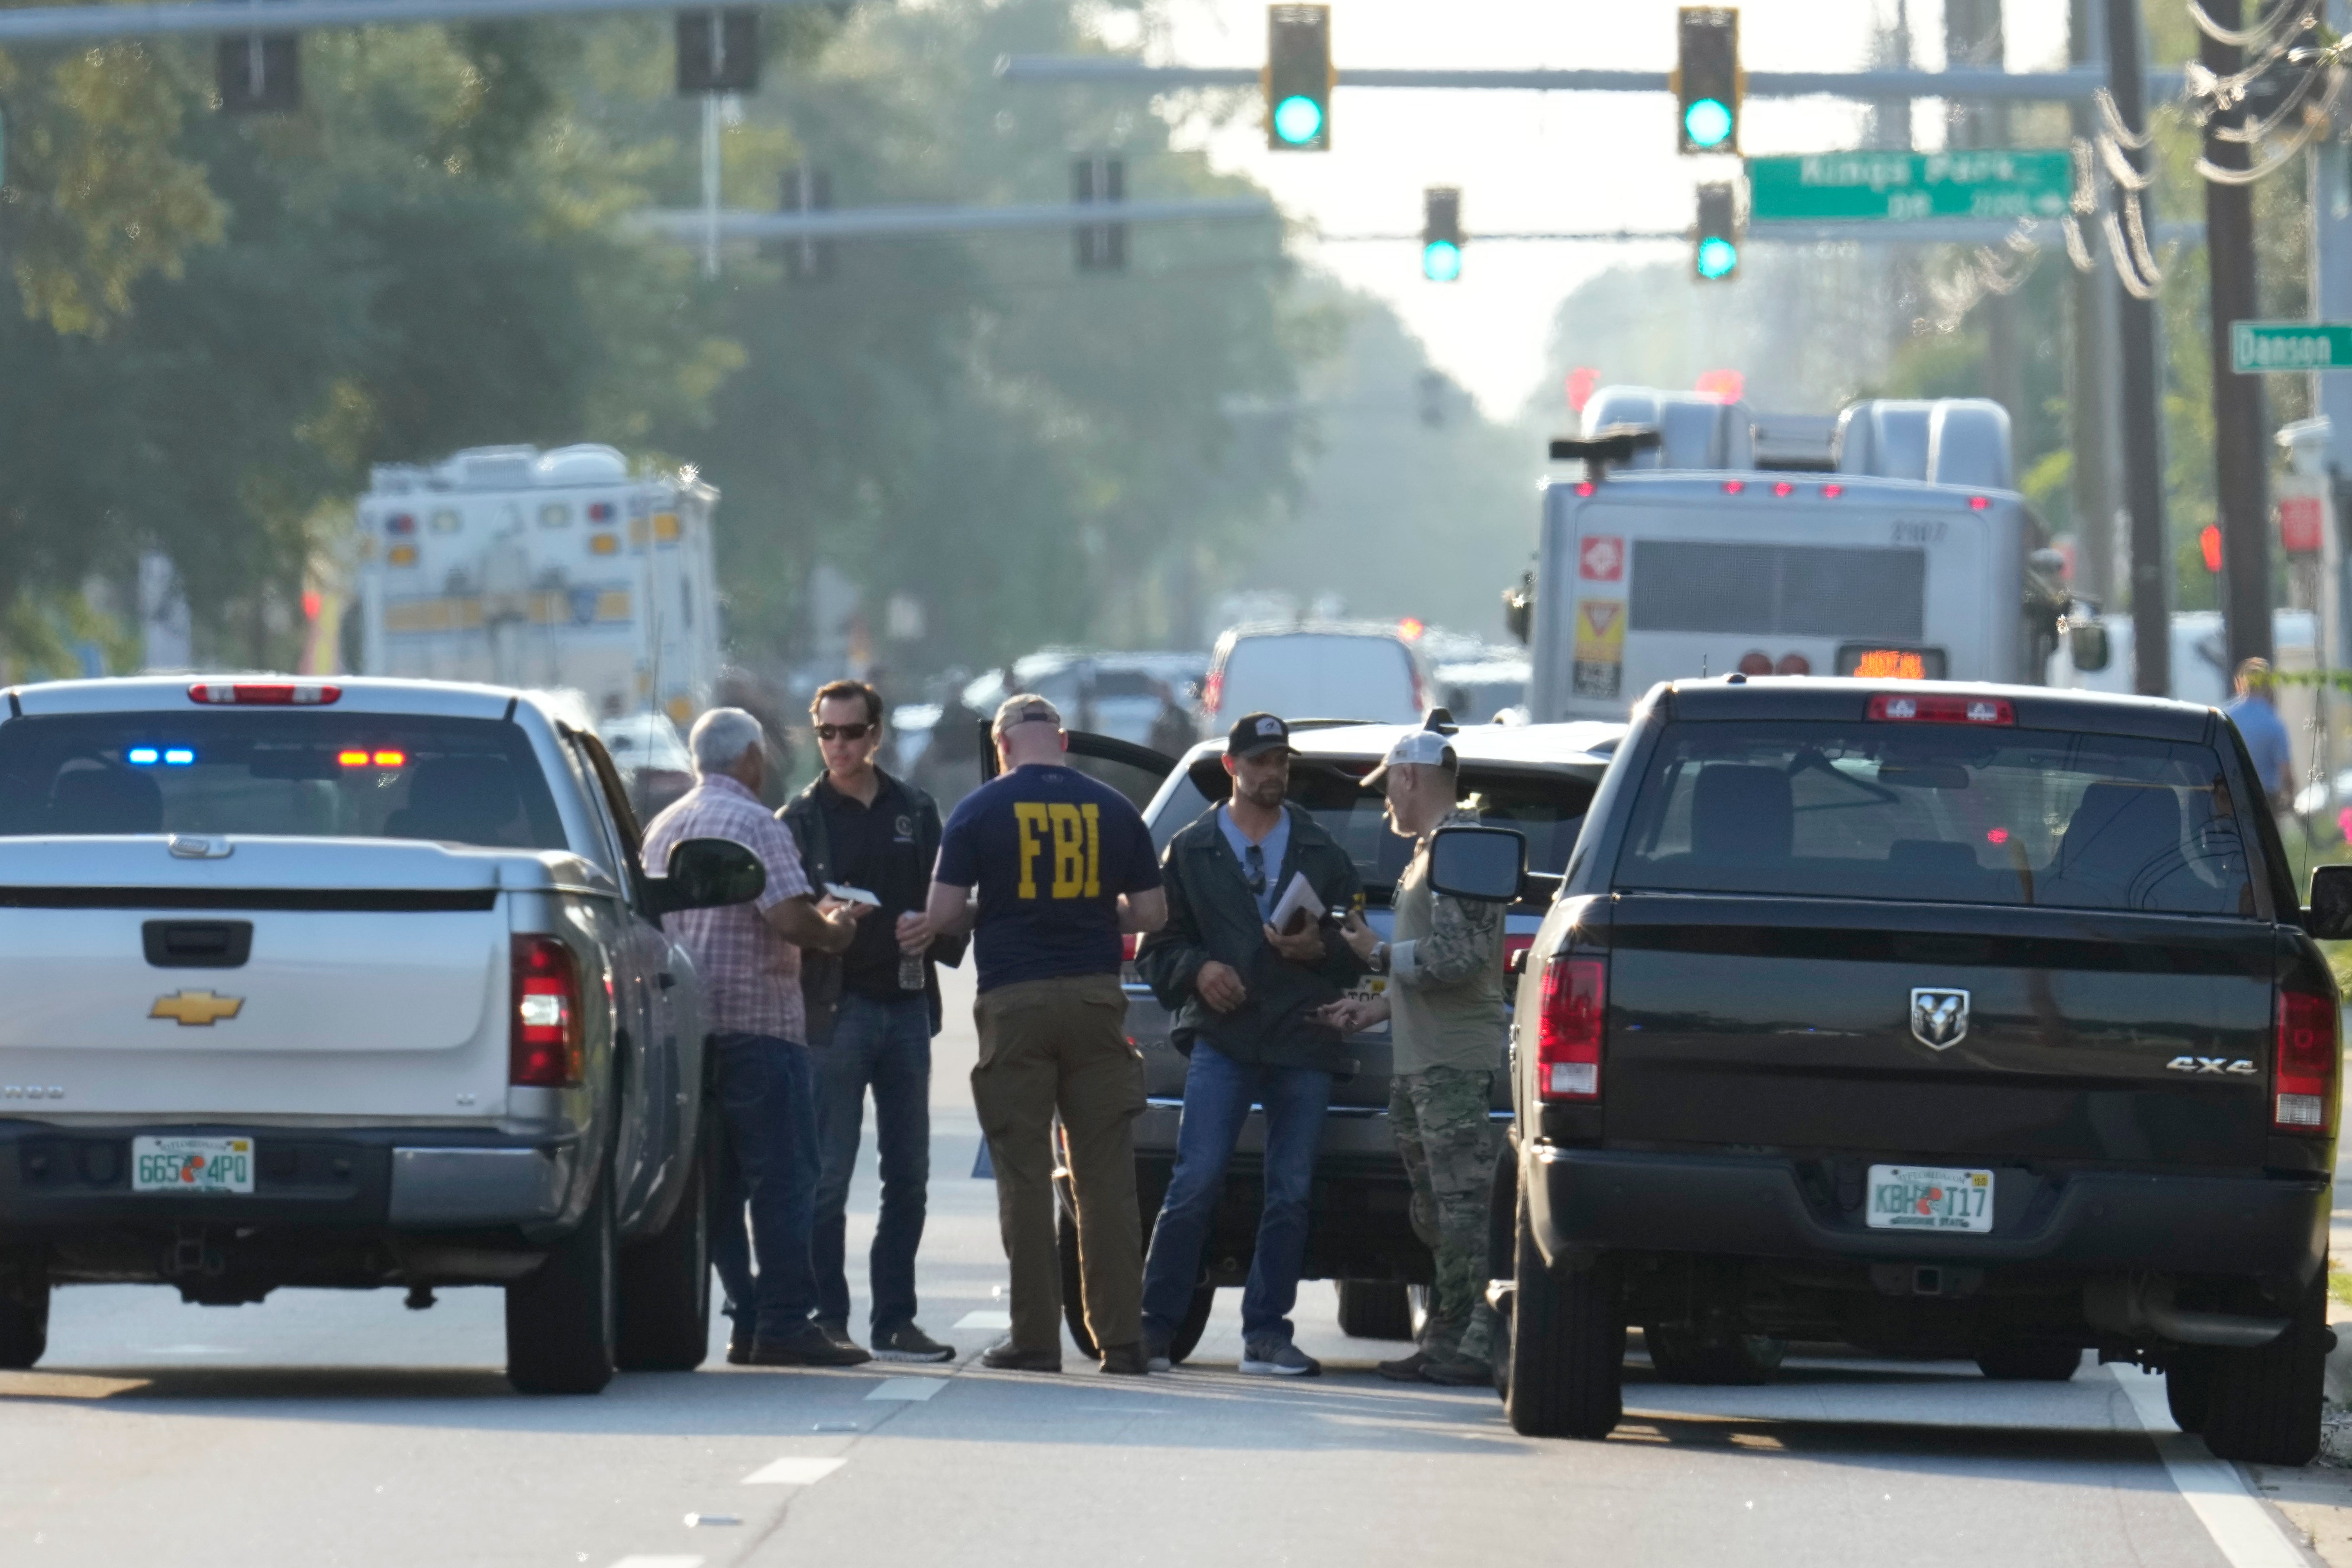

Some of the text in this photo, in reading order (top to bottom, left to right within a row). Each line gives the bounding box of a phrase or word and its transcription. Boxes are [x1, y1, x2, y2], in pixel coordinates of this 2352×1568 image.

[2239, 331, 2332, 365] Danson
[1013, 802, 1100, 899] FBI
[2166, 1055, 2258, 1075] 4X4
[140, 1155, 179, 1183] 665
[1875, 1184, 1986, 1217] KBH T17
